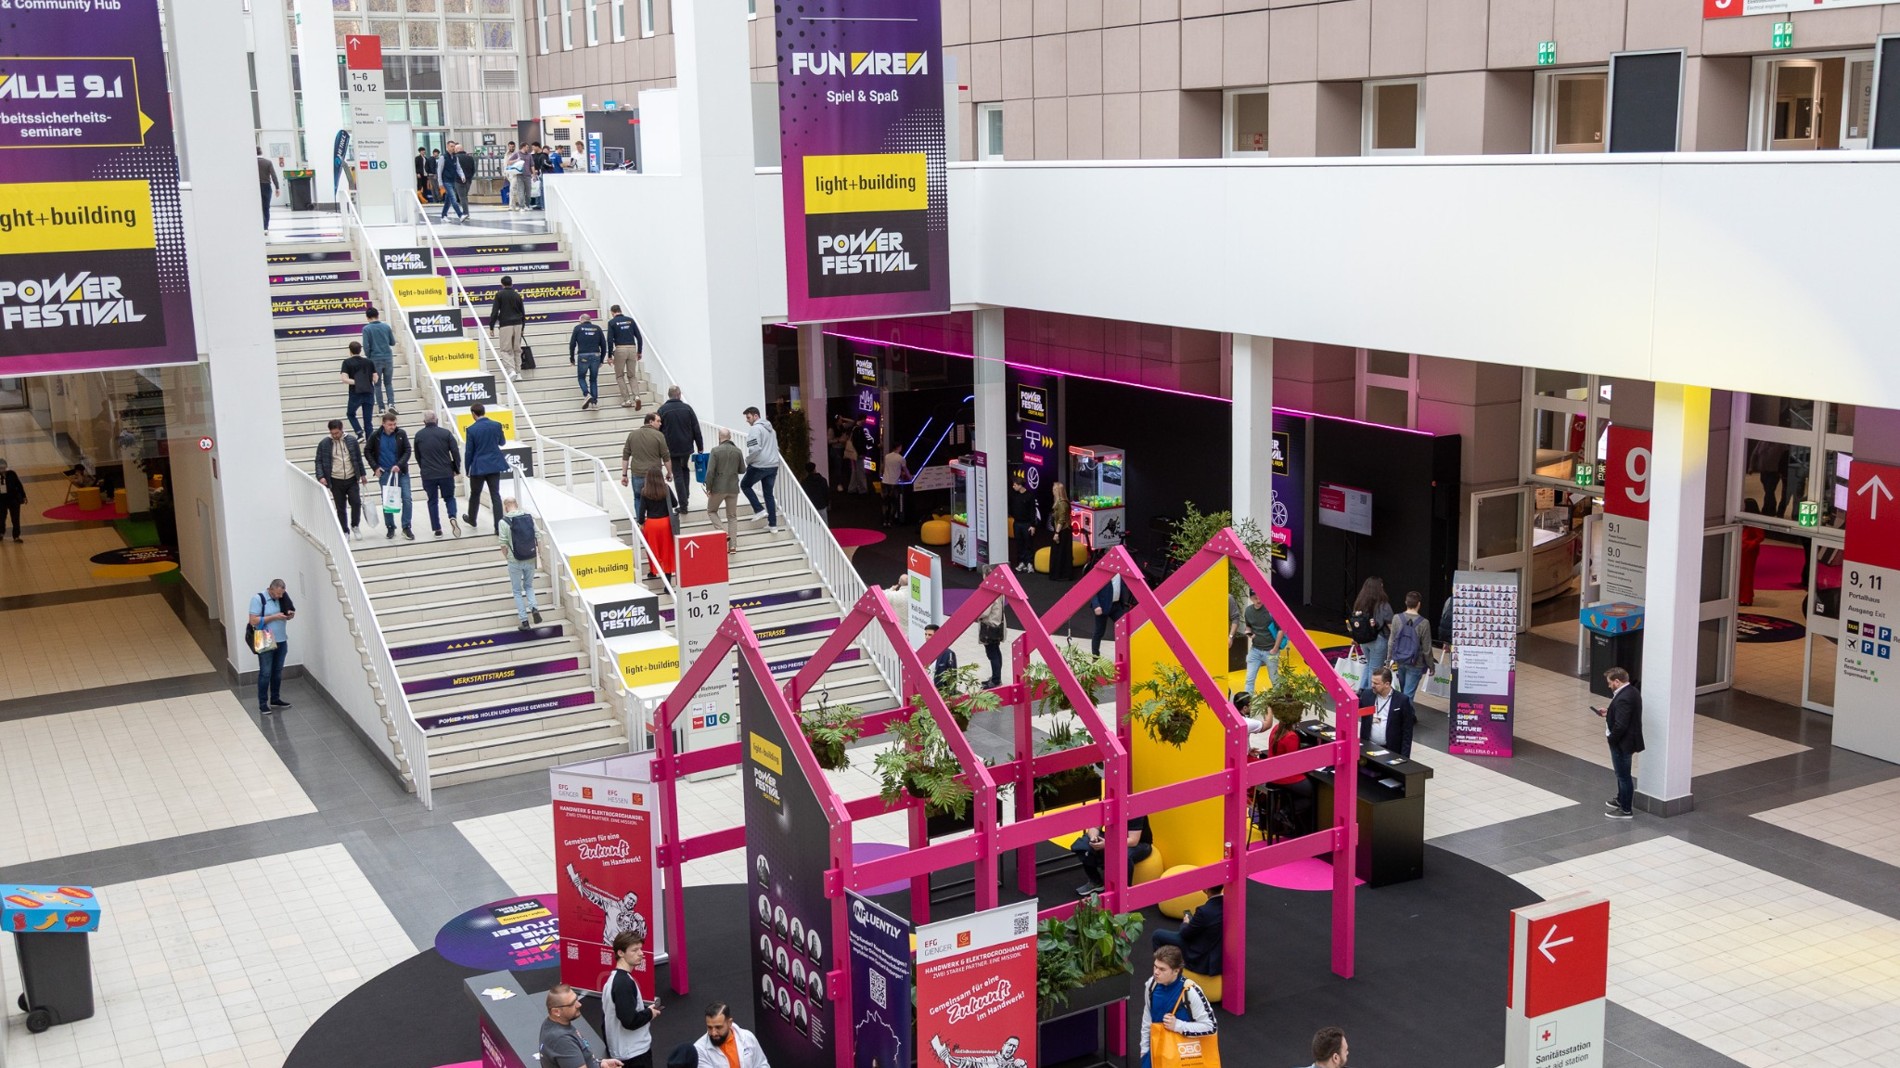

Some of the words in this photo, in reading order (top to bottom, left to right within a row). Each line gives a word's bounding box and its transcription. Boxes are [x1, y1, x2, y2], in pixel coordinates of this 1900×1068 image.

[15, 0, 90, 12] Community
[95, 0, 121, 10] Hub
[792, 50, 846, 78] FUN
[851, 50, 928, 75] AREA
[0, 73, 76, 99] ALLE
[83, 75, 123, 98] 9.1
[353, 84, 365, 92] 10,
[368, 84, 377, 92] 12
[826, 90, 855, 105] Spiel
[857, 90, 867, 102] &
[869, 89, 899, 104] Spaß
[0, 112, 112, 124] beitssicherheits-
[20, 126, 82, 138] seminare
[815, 174, 916, 195] light+building
[0, 205, 137, 232] ght+building
[818, 227, 904, 255] POWER
[384, 252, 421, 263] POWER
[822, 250, 918, 276] FESTIVAL
[386, 261, 427, 270] FESTIVAL
[343, 296, 368, 308] AREA
[3, 298, 147, 330] FESTIVAL
[413, 314, 451, 326] POWER
[416, 323, 457, 334] FESTIVAL
[445, 381, 485, 394] POWER
[447, 390, 491, 402] FESTIVAL
[1021, 391, 1041, 403] POWER
[1022, 400, 1044, 412] FESTIVAL
[1625, 447, 1651, 503] 9
[1608, 523, 1620, 533] 9.1
[1272, 531, 1287, 542] harity
[1607, 547, 1620, 558] 9.0
[576, 563, 628, 576] light+building
[1850, 571, 1863, 589] 9,
[1869, 575, 1882, 590] 11
[1848, 592, 1880, 604] Portalhaus
[600, 605, 646, 621] POWER
[688, 606, 704, 618] 10,
[707, 604, 720, 615] 12
[1848, 605, 1874, 617] Ausgang
[1874, 610, 1886, 619] Exit
[602, 614, 653, 630] FESTIVAL
[1881, 630, 1889, 640] P
[1864, 642, 1871, 652] P
[1880, 647, 1887, 656] 9
[625, 660, 680, 675] light+building
[700, 683, 727, 692] Richtungen
[480, 711, 498, 719] HOLEN
[499, 708, 510, 716] UND
[510, 705, 530, 714] PREISE
[708, 716, 715, 725] U
[721, 714, 728, 723] S
[753, 767, 777, 788] POWER
[755, 777, 780, 800] FESTIVAL
[564, 837, 597, 846] Gemeinsam
[598, 834, 607, 842] für
[578, 839, 630, 860] Zukunft
[610, 856, 641, 866] Handwerk!
[853, 901, 901, 939] INFLUENTLY
[491, 918, 560, 938] UTURE!
[924, 938, 937, 948] EFG
[924, 944, 952, 956] GIENGER
[925, 960, 959, 974] HANDWERK
[932, 971, 946, 979] ZWEI
[946, 967, 965, 976] STARKE
[965, 961, 988, 971] PARTNER.
[929, 990, 971, 1015] Gemeinsam
[972, 983, 983, 993] für
[984, 975, 999, 987] eine
[946, 979, 1011, 1024] Zukunft
[977, 1011, 987, 1021] im
[987, 991, 1025, 1015] Handwerk!
[1178, 1044, 1202, 1055] OBO
[1536, 1042, 1591, 1064] Sanitätsstation
[1565, 1053, 1589, 1066] station
